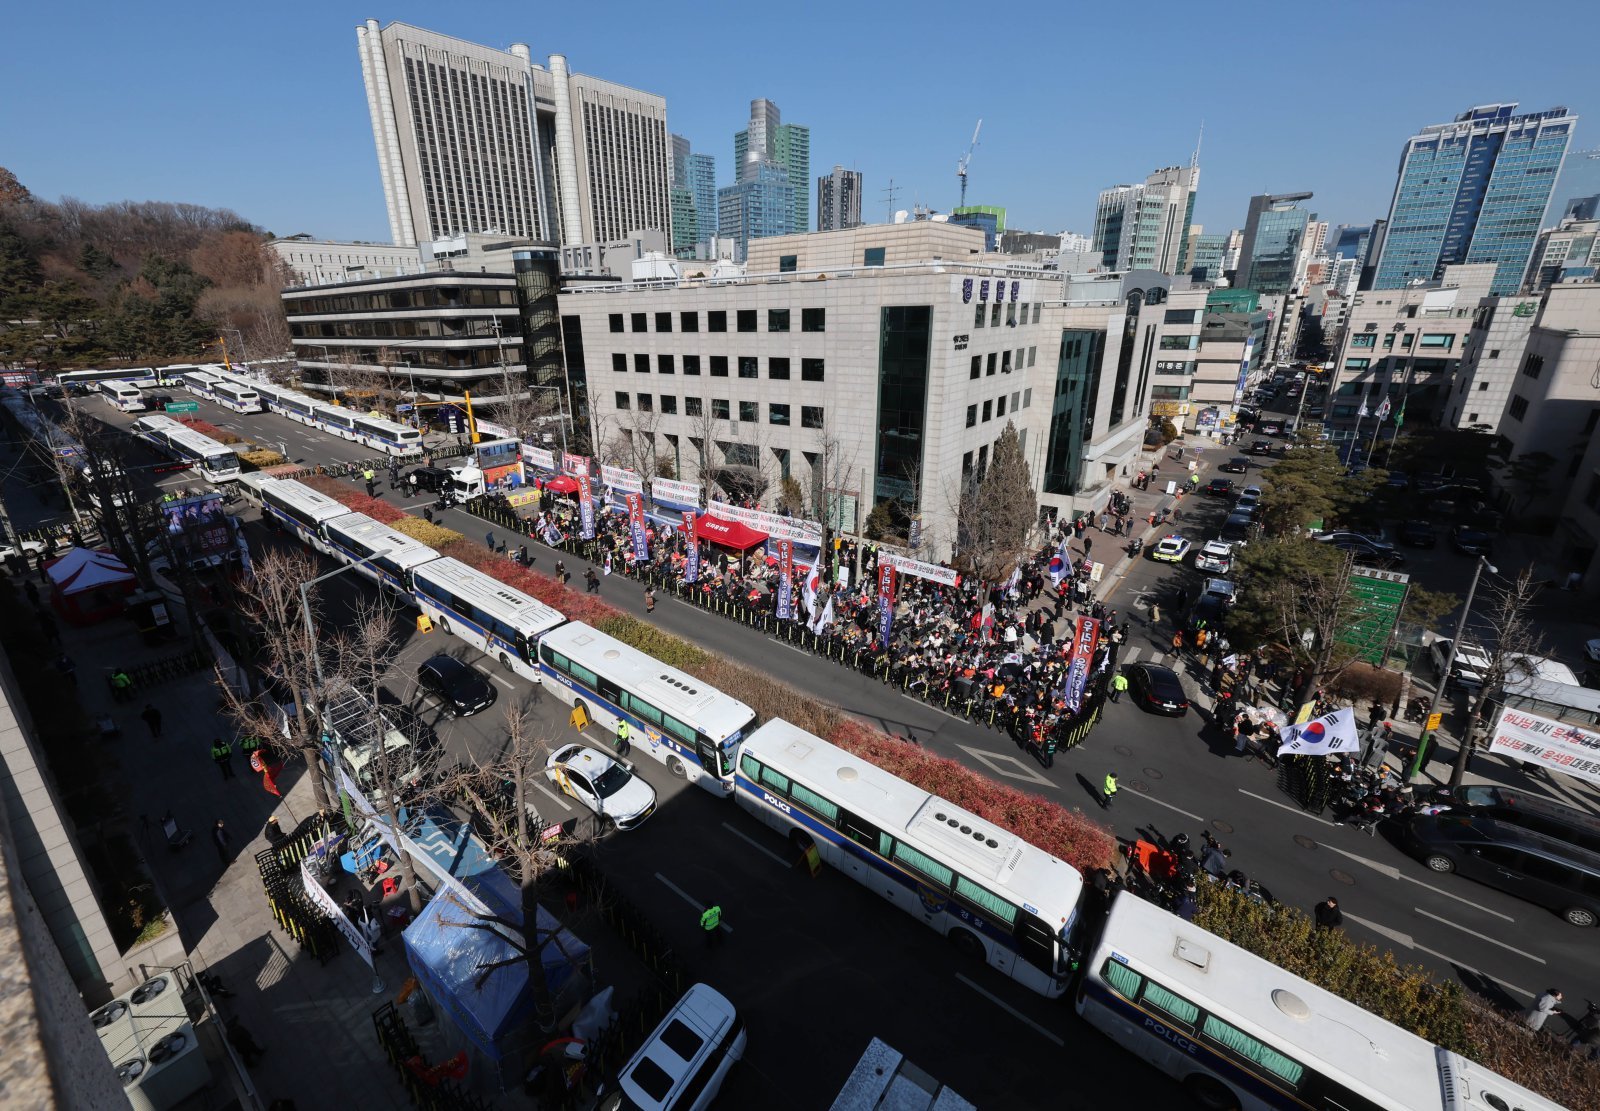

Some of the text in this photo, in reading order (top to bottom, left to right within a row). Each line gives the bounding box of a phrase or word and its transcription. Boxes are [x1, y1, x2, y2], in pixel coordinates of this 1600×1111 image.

[1503, 712, 1554, 735] 하나님께서
[1495, 735, 1545, 756] 하나님께서
[764, 793, 791, 814] POLICE
[1144, 1017, 1199, 1056] POLICE
